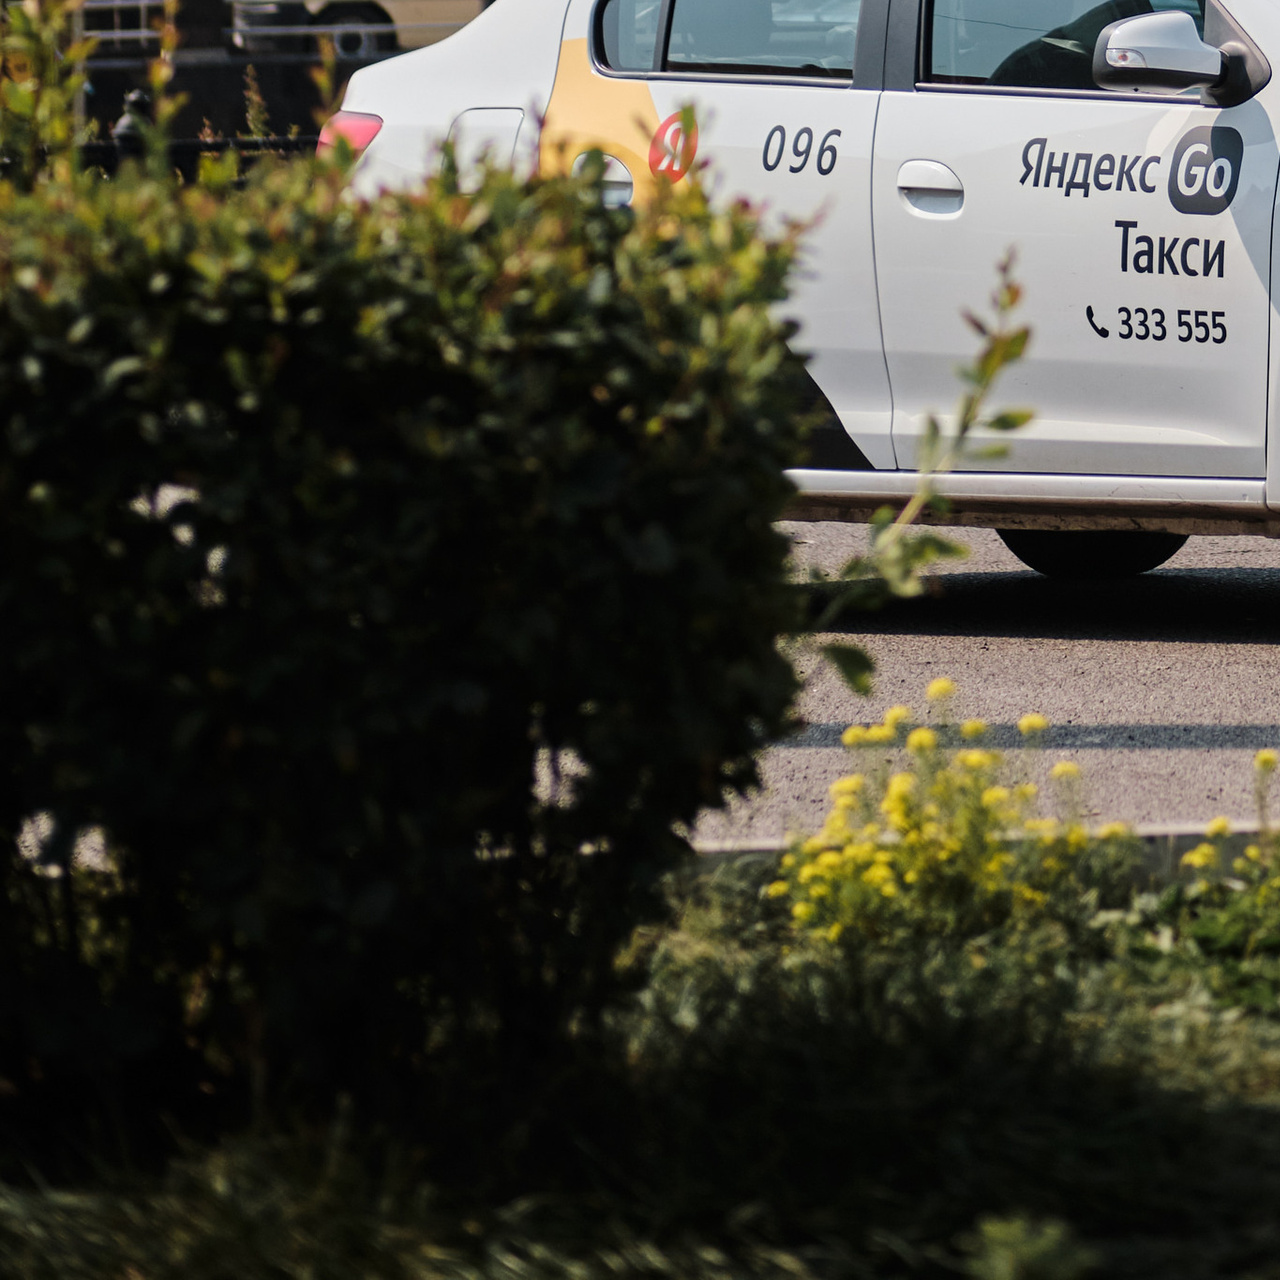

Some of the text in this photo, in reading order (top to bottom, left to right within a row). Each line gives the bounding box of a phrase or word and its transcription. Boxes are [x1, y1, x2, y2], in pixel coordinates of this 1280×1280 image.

[657, 121, 688, 171] Я
[762, 124, 842, 176] 096
[1019, 137, 1232, 198] Яндекс Go
[1115, 220, 1225, 278] Такси
[1118, 307, 1227, 344] 333 555
